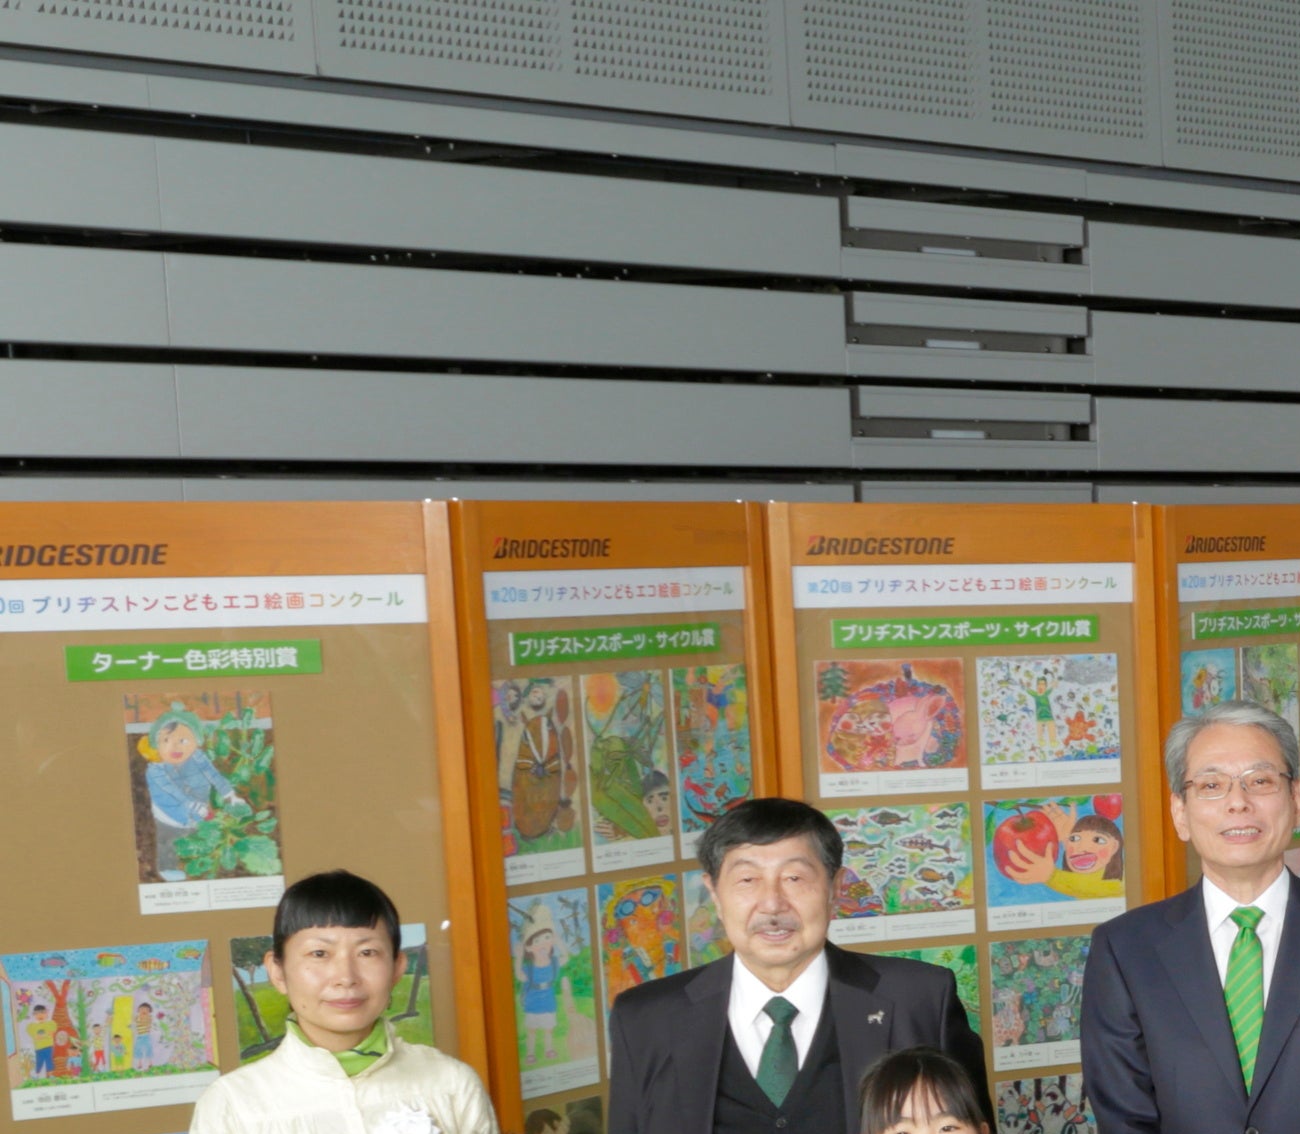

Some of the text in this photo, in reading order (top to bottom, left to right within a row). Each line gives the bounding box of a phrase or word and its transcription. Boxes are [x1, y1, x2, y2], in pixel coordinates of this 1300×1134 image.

[0, 543, 169, 567] IDGESTONE
[493, 537, 612, 559] BRIDGESTONE
[806, 535, 956, 556] BRIDGESTONE
[1184, 535, 1267, 554] BRIDGESTONE
